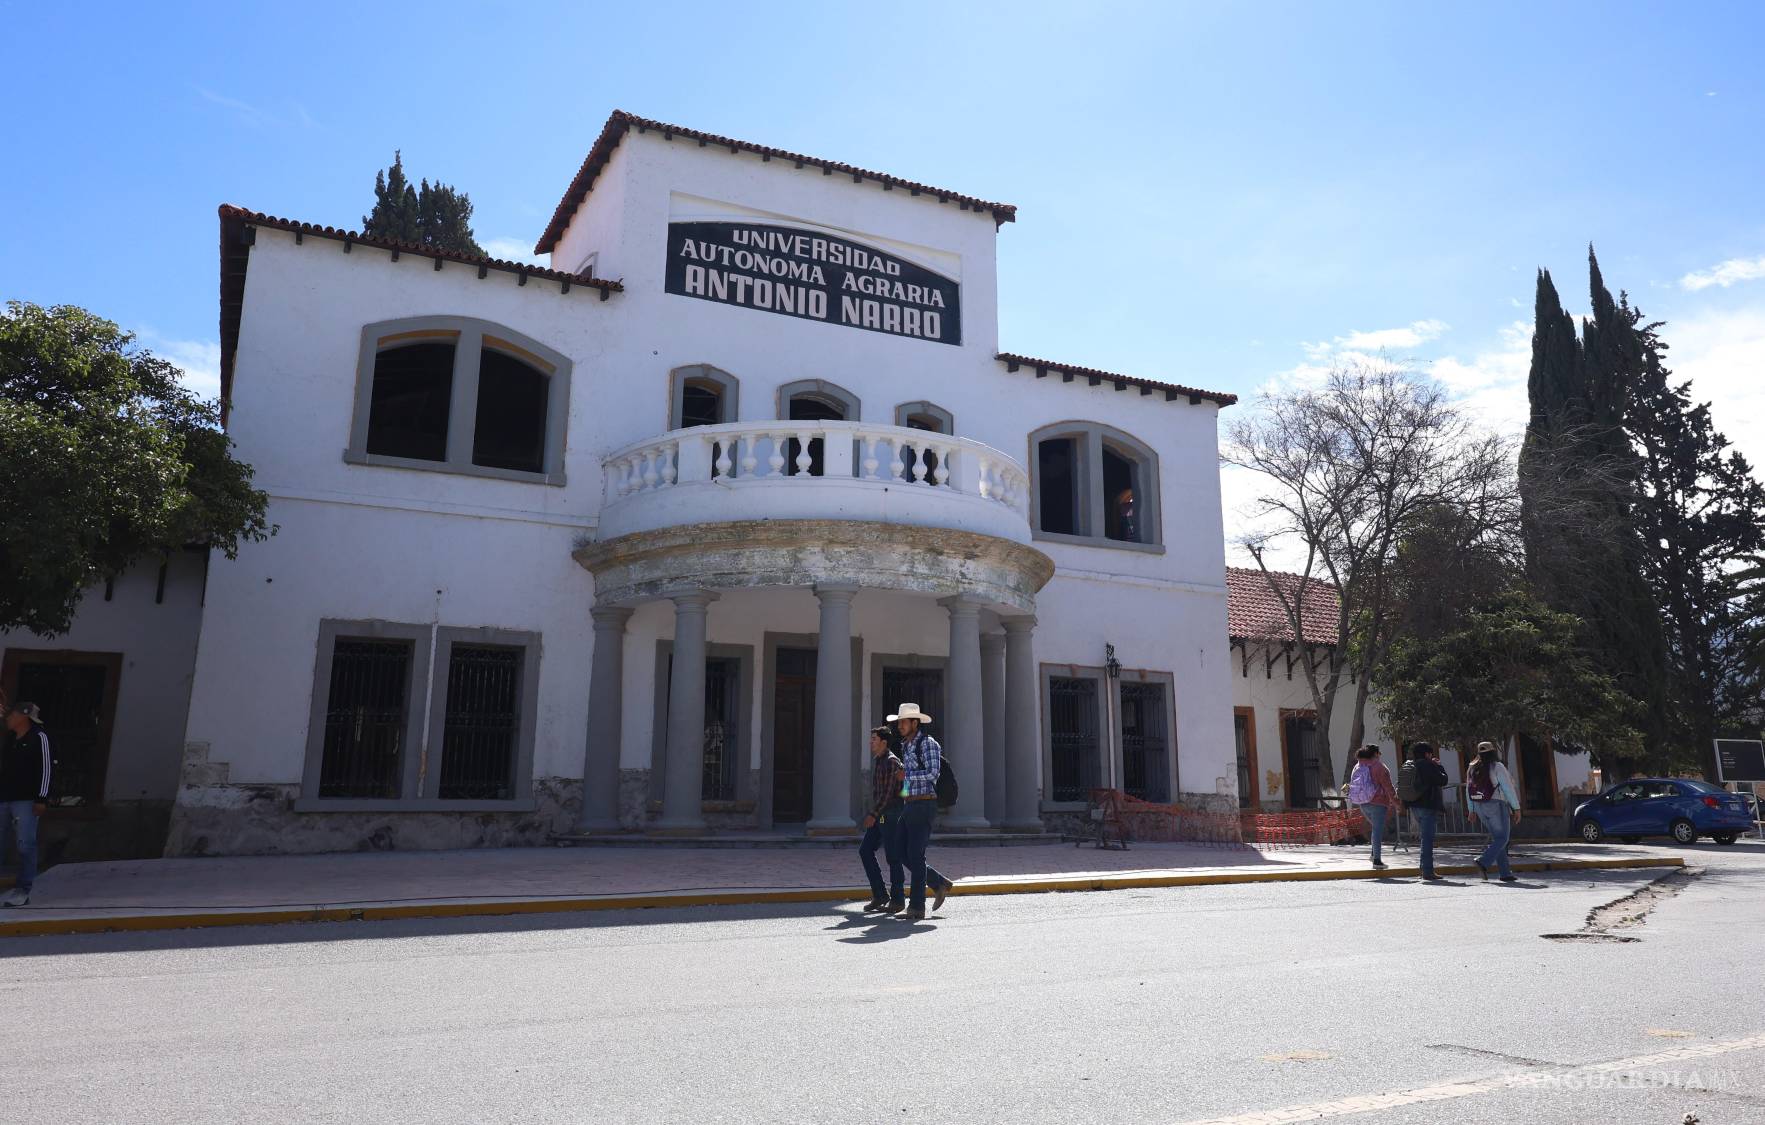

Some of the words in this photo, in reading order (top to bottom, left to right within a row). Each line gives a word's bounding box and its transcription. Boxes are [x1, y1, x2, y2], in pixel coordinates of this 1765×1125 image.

[679, 238, 827, 286] AUTONOMA
[841, 271, 945, 308] AGRARIA
[733, 229, 900, 276] UNIVERSIDAD
[685, 264, 827, 319] ANTONIO
[841, 295, 941, 339] NARRO
